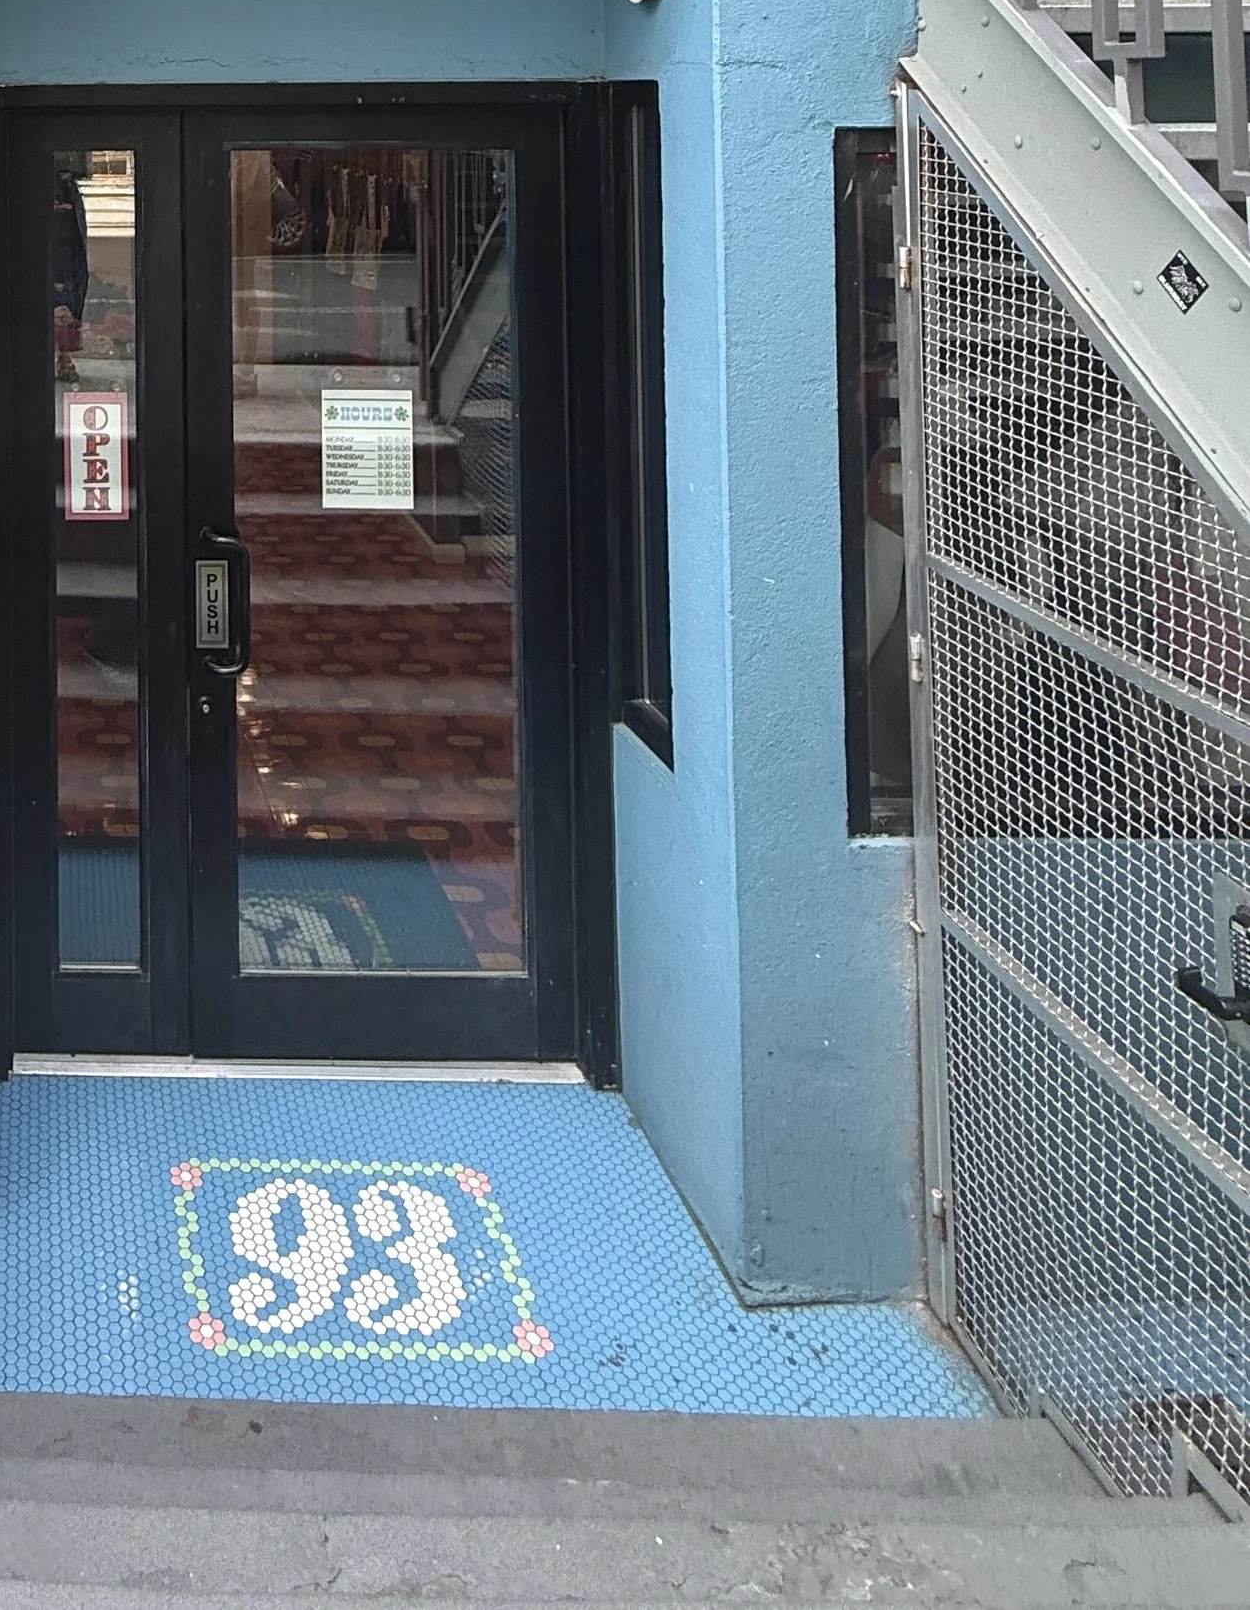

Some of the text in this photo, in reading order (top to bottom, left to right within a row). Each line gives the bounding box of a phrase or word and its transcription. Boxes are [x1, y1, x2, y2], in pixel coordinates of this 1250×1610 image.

[340, 406, 393, 422] HOURS
[82, 405, 112, 511] OPEN
[206, 573, 219, 635] PUSH
[228, 1177, 467, 1336] 93
